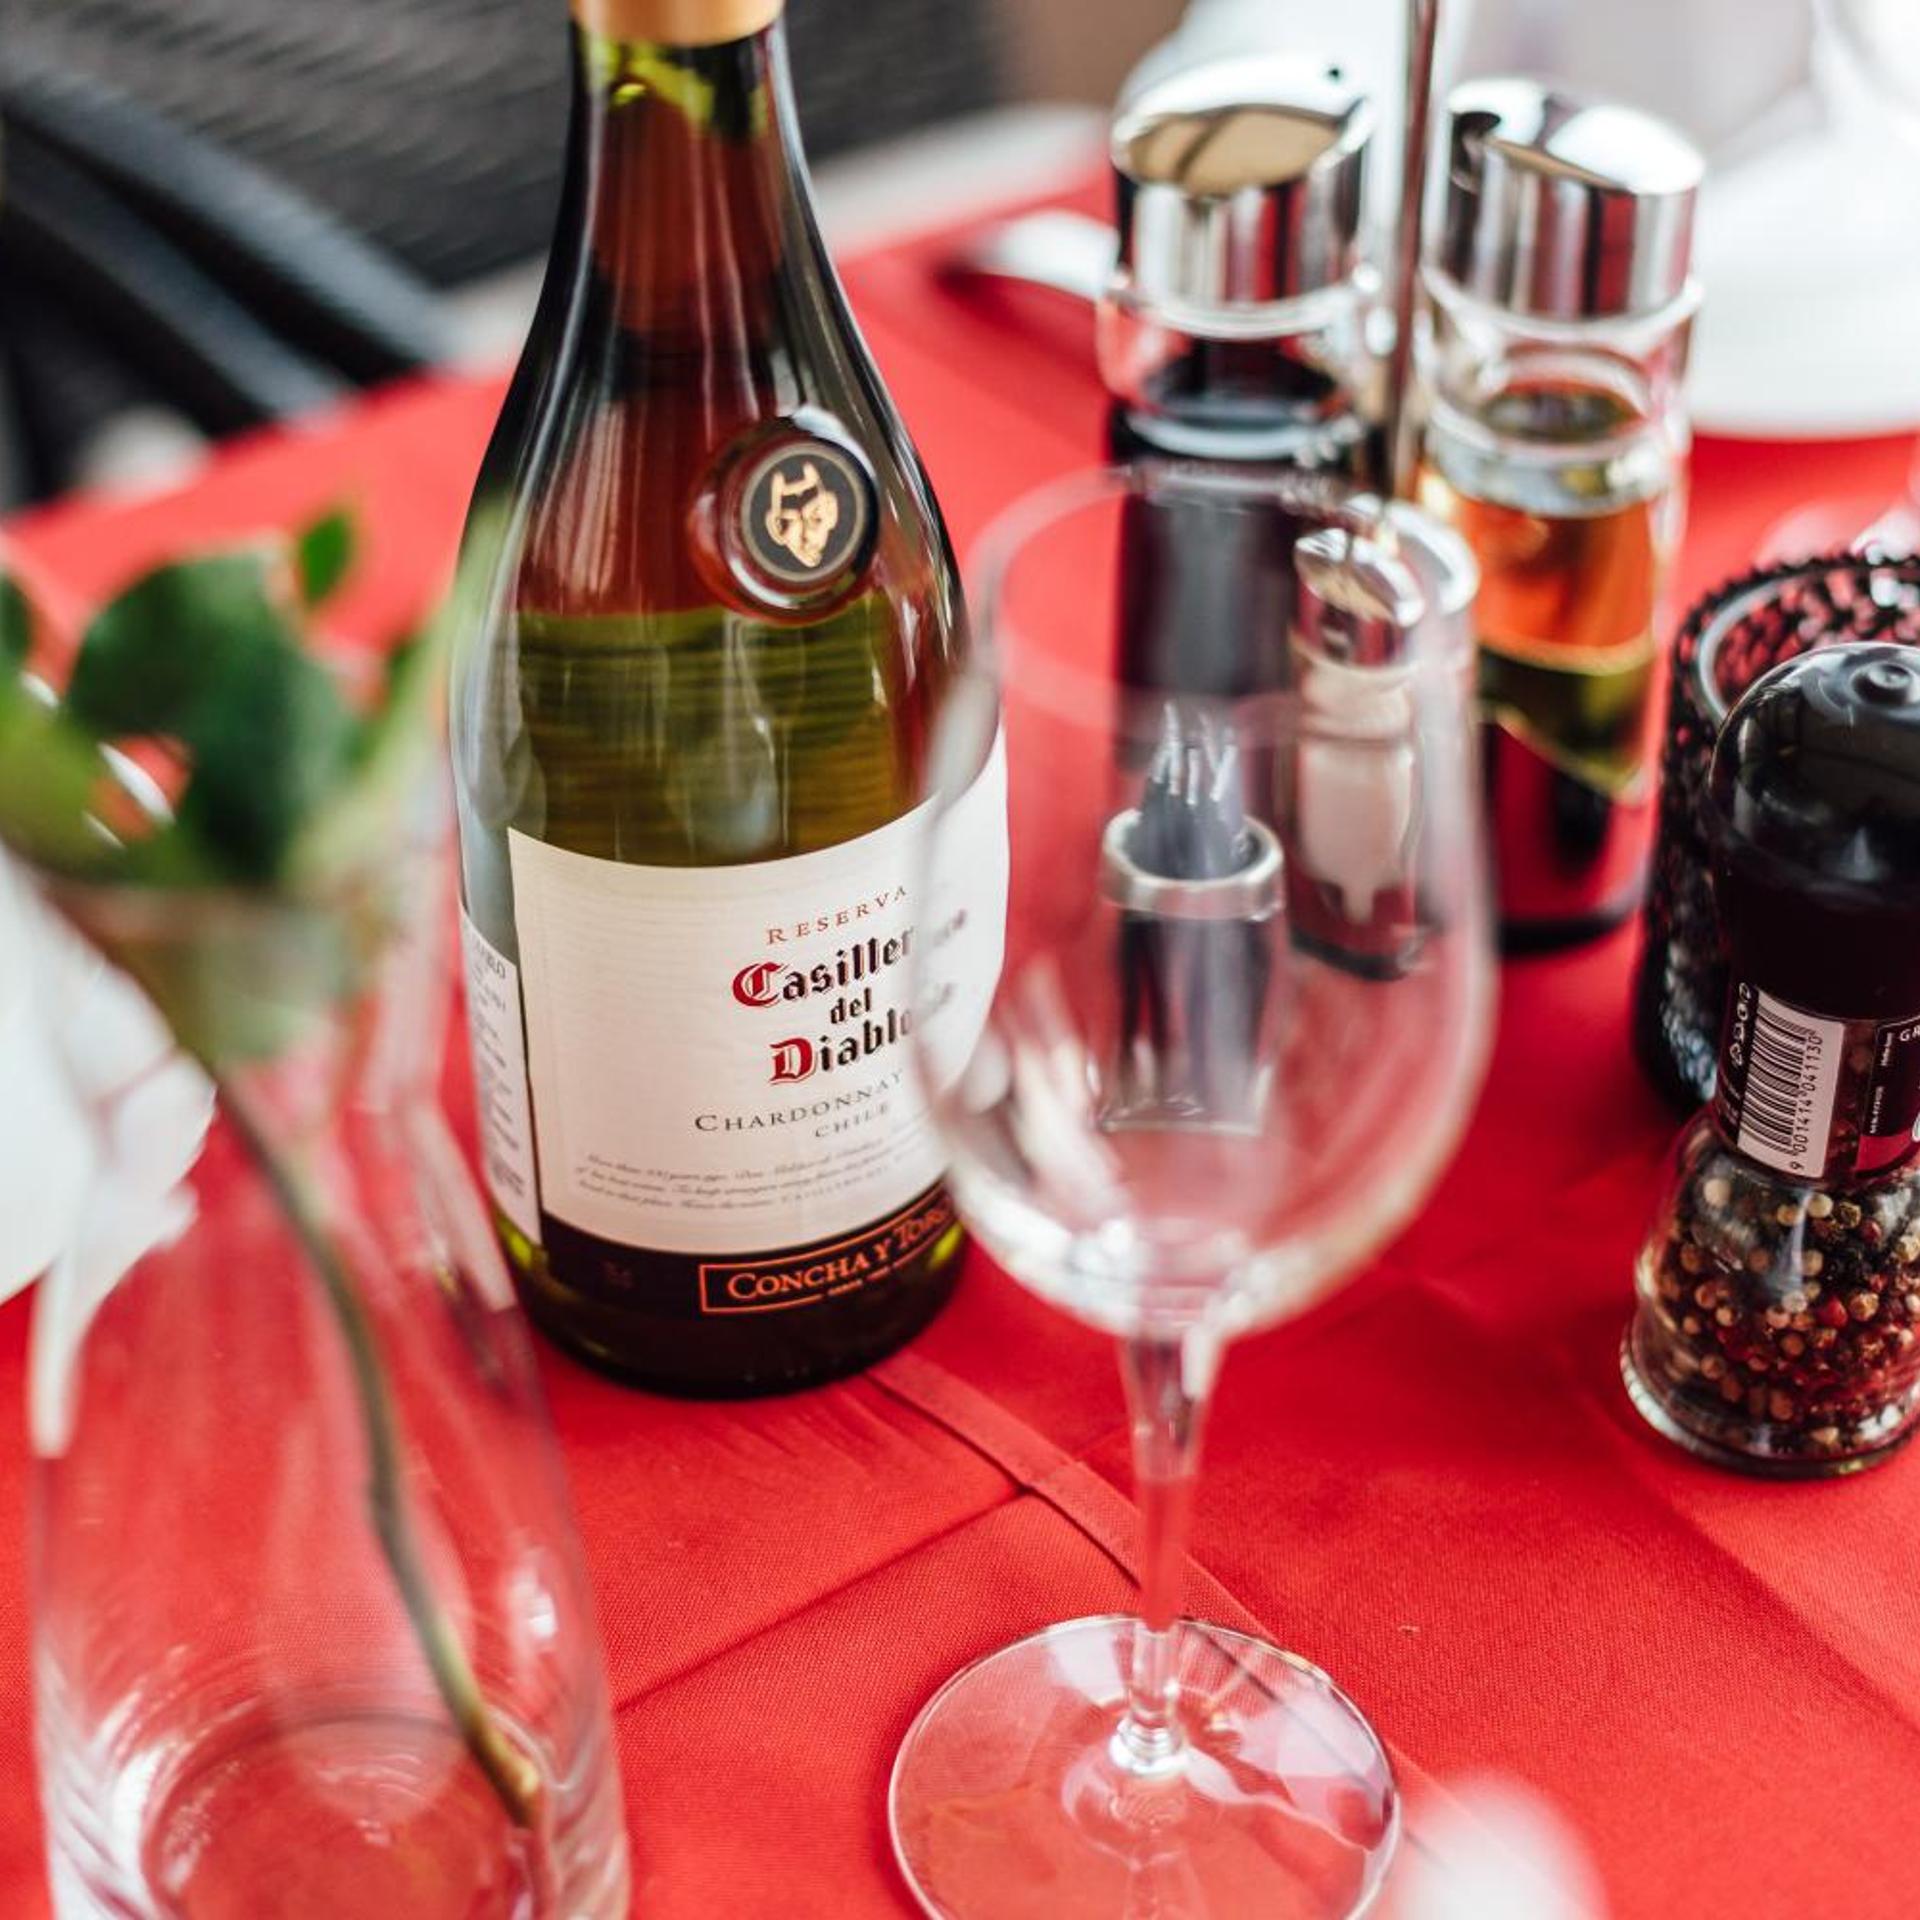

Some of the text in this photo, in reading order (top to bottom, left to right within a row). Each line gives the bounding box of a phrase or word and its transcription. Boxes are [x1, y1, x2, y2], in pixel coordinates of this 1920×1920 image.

[766, 885, 906, 945] RESERVA
[732, 926, 916, 1008] Casiller
[829, 987, 872, 1024] del
[694, 1069, 903, 1131] CHARDONNAY
[815, 1103, 888, 1137] CHILE
[727, 1252, 870, 1300] CONCHA
[873, 1237, 892, 1260] Y
